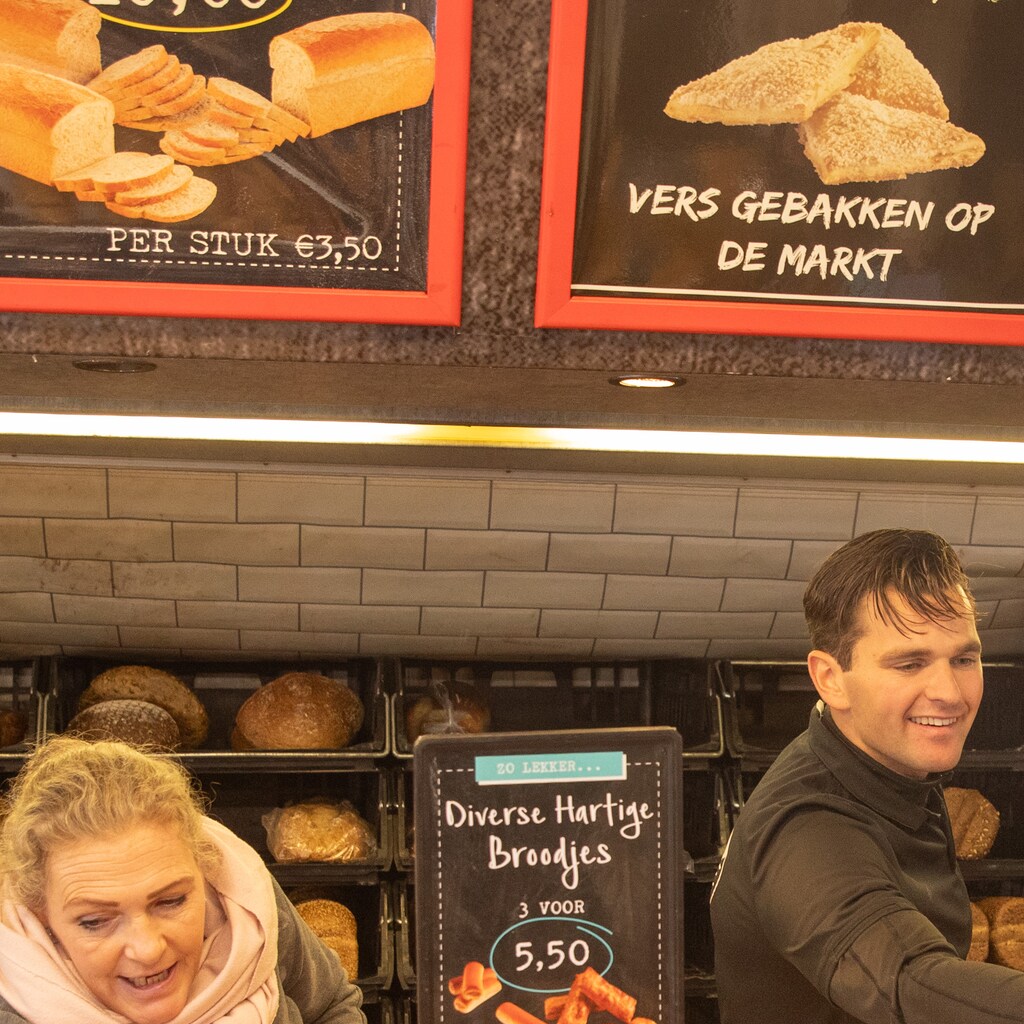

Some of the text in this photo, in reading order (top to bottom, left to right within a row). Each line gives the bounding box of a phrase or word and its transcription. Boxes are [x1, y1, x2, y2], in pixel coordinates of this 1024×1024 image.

[629, 183, 995, 235] VERS GEBAKKEN OP
[105, 227, 383, 264] PER STUK €3,50
[718, 240, 902, 282] DE MARKT
[495, 762, 516, 775] ZO
[446, 793, 654, 841] Diverse Hartige
[488, 835, 611, 890] Broodjes
[519, 900, 585, 918] 3 VOOR
[516, 940, 590, 971] 5,50
